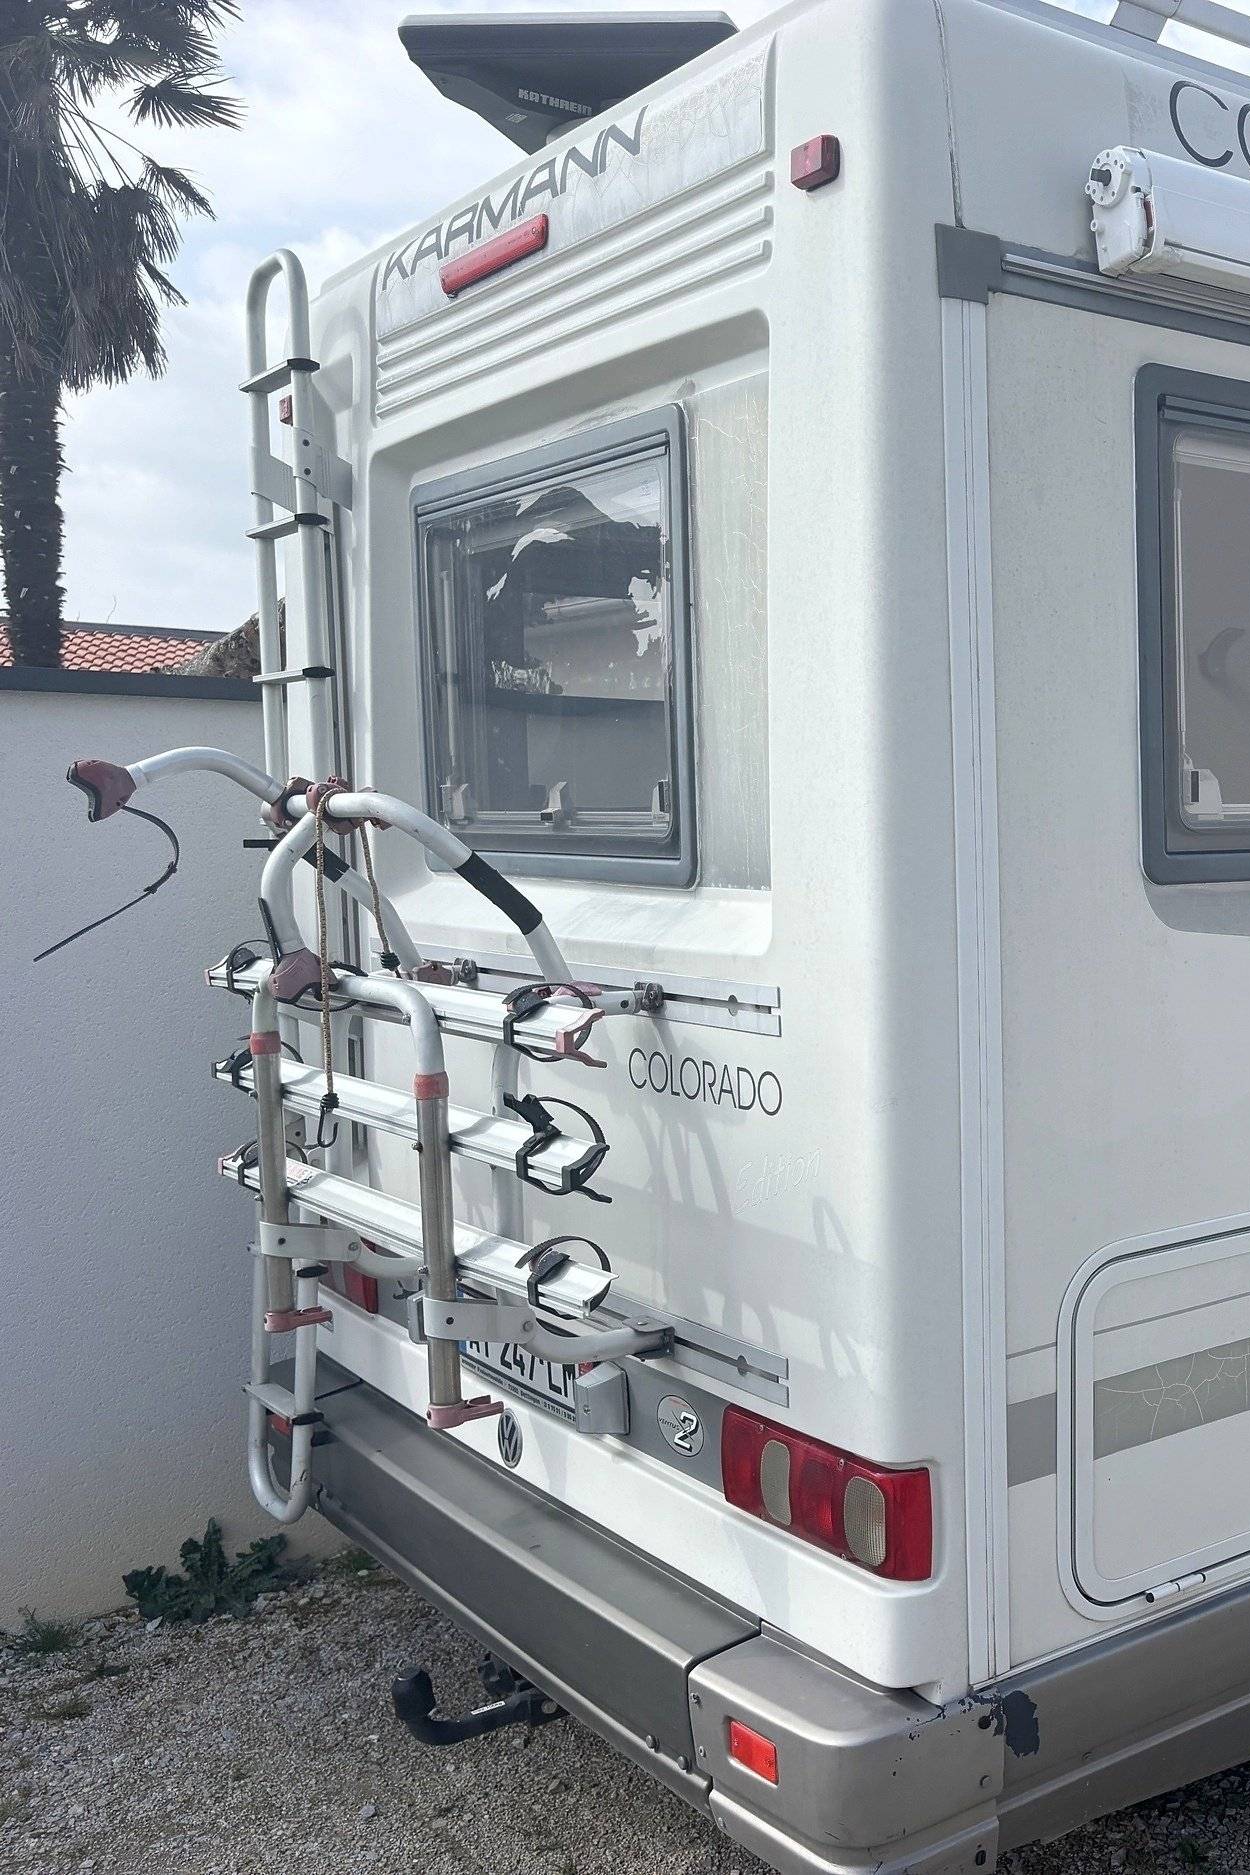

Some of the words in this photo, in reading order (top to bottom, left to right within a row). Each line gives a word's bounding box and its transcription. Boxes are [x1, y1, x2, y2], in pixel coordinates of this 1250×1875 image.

[518, 88, 592, 116] KATHREIN
[382, 104, 649, 292] KARMANN
[628, 1047, 782, 1116] COLORADO
